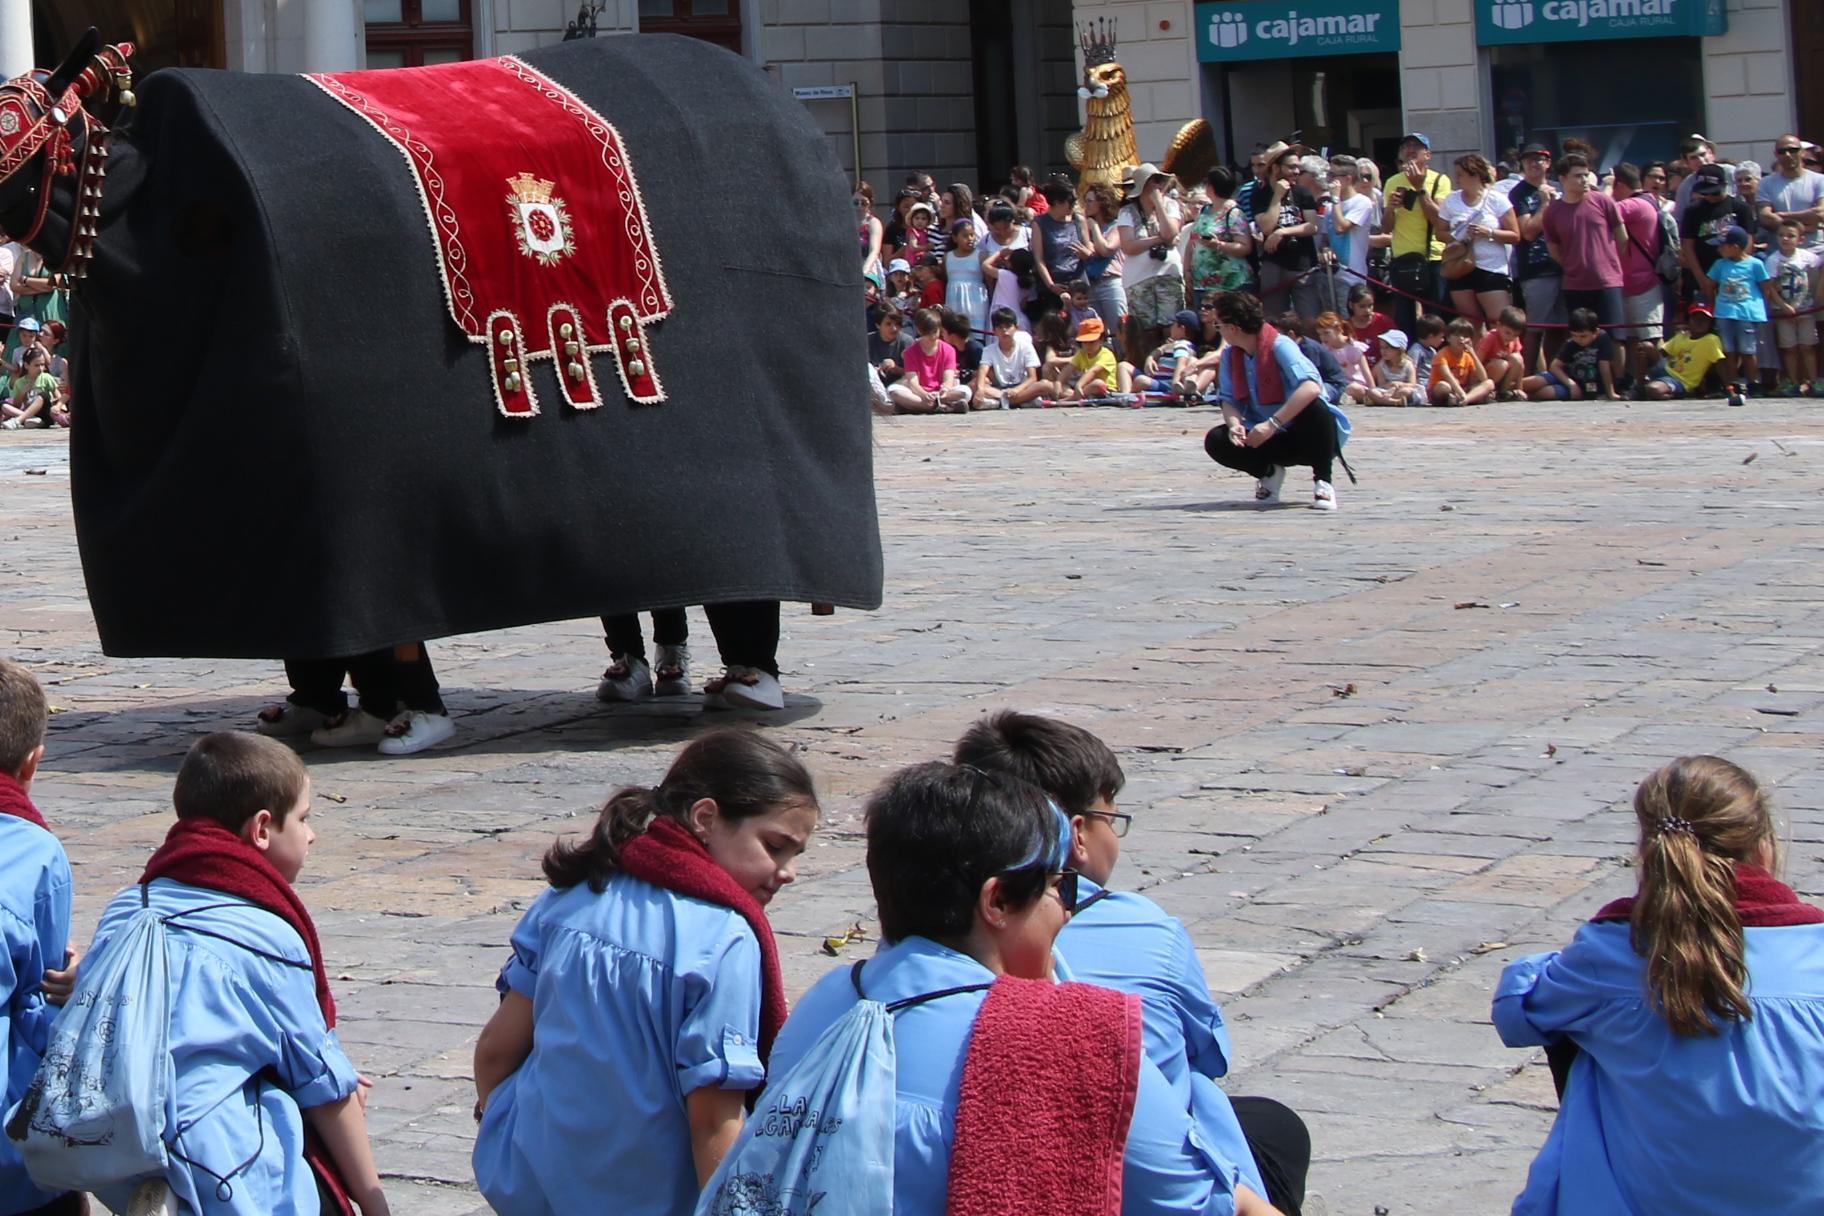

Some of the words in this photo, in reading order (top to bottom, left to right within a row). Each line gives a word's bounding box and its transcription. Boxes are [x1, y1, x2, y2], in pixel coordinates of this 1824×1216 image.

[1255, 10, 1380, 46] cajamar
[1608, 18, 1637, 28] CAJA
[1639, 15, 1676, 27] RURAL
[1316, 35, 1344, 46] CAJA
[1345, 33, 1379, 45] RURAL
